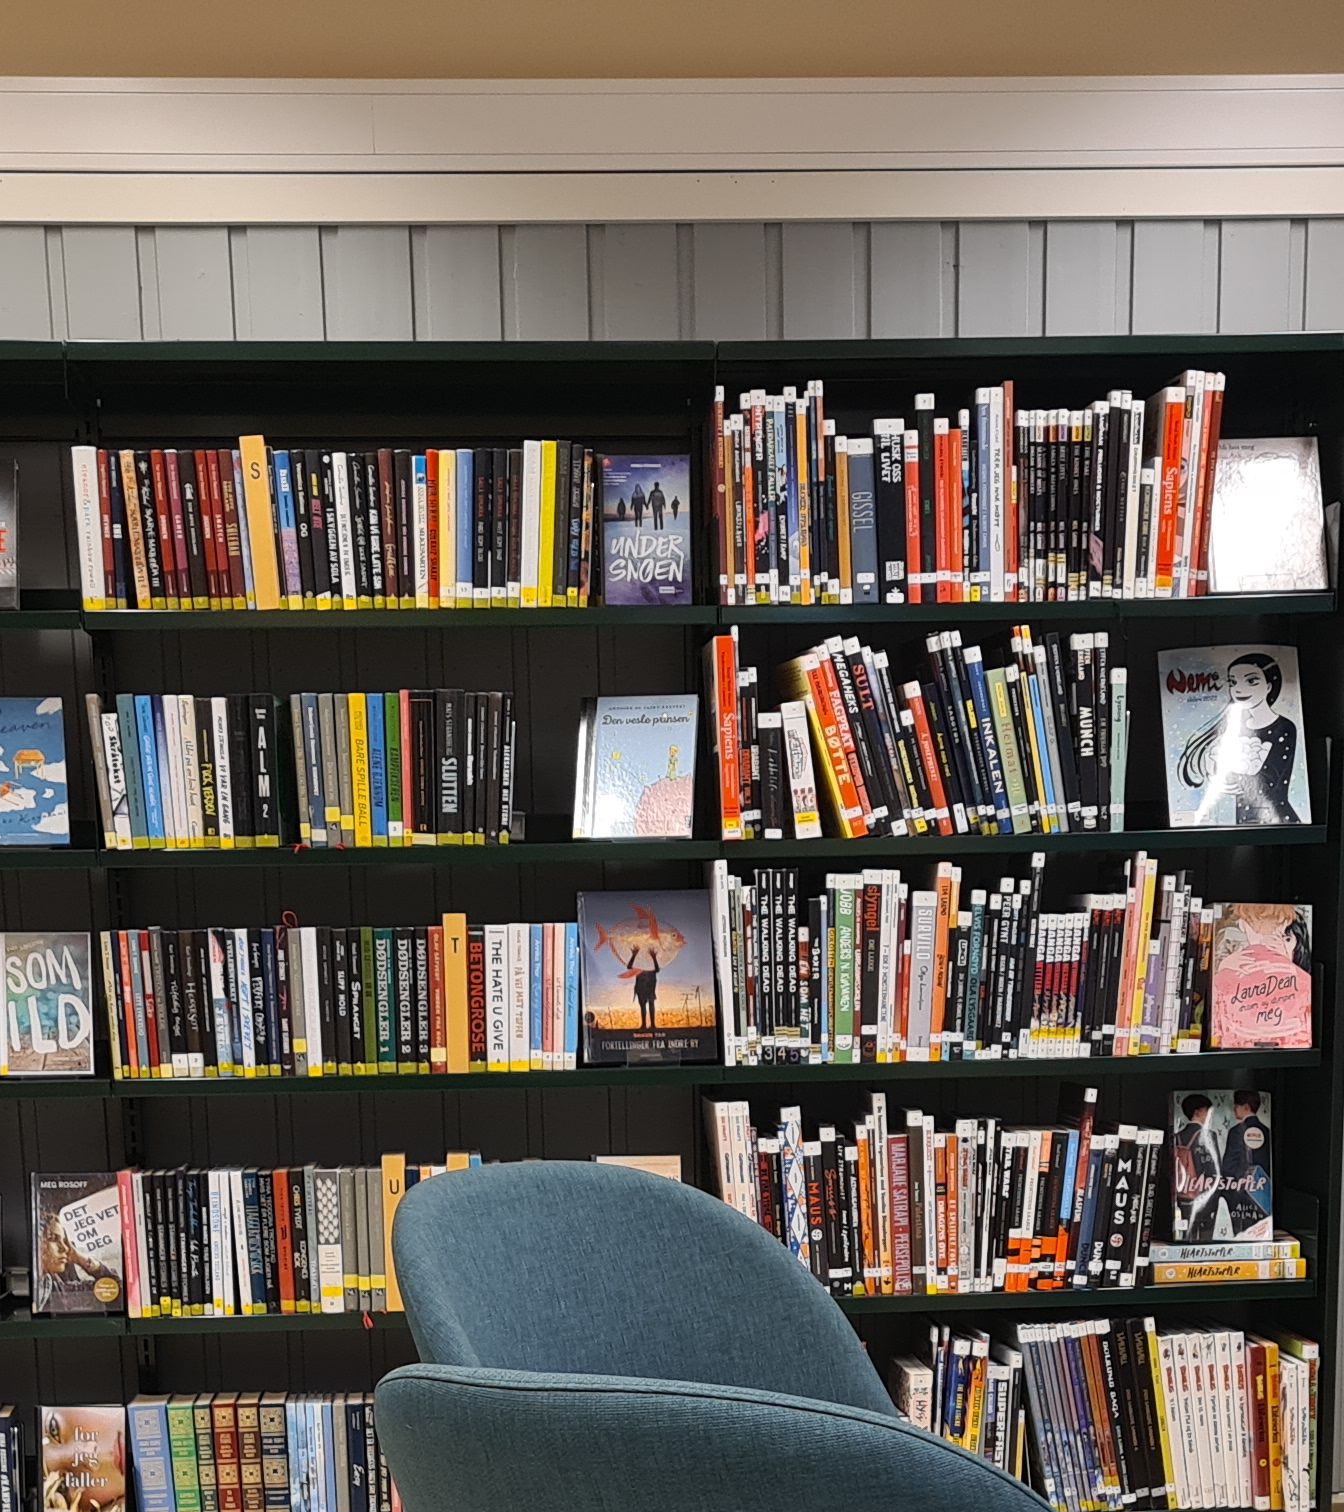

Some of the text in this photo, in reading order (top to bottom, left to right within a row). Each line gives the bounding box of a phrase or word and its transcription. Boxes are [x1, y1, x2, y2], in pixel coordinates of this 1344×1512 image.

[251, 462, 261, 479] S
[881, 452, 891, 483] LIVET
[892, 464, 901, 483] OSS
[1164, 467, 1177, 515] Sapiens
[852, 491, 873, 532] GISSEL
[610, 529, 684, 559] UNDER
[832, 654, 858, 714] MEGAHEKS
[852, 664, 874, 710] SULT
[1166, 668, 1222, 696] Nemi
[601, 714, 624, 726] Den
[652, 714, 690, 728] prinsen
[721, 713, 734, 760] Sapiens
[830, 689, 855, 750] FAGPRAT
[1078, 706, 1094, 757] MUNCH
[109, 736, 121, 784] Skråtekst
[824, 725, 850, 785] BØTTE
[981, 717, 1003, 794] INKALEN
[355, 738, 368, 827] BARE SPILLE BALL
[441, 757, 458, 813] SLUTTEN
[775, 895, 783, 915] THE
[788, 895, 796, 914] THE
[839, 888, 852, 915] JOBB
[864, 885, 880, 931] slyngel
[973, 907, 982, 929] ELVIS
[1000, 895, 1011, 943] PEER GYNT
[451, 937, 459, 953] T
[761, 918, 769, 962] WALKING
[775, 918, 784, 962] WALKING
[788, 918, 796, 962] WALKING
[839, 926, 851, 959] ANDERS
[915, 908, 933, 960] SURVILO
[971, 932, 981, 974] FORNØYD
[6, 945, 82, 994] SOM
[337, 970, 345, 991] SLIPP
[762, 965, 770, 993] DEAD
[776, 965, 784, 993] DEAD
[969, 978, 978, 995] OLA
[1231, 981, 1266, 1004] Laura
[1265, 974, 1299, 998] Dean
[375, 939, 388, 1041] DØDSENGLER
[397, 939, 411, 1054] DØDSENGLER 2
[416, 938, 428, 1053] DØDSENGLER 3
[470, 942, 484, 1052] BETONGROSE
[491, 939, 504, 1051] THE HATE U GIVE
[8, 993, 91, 1054] ILD
[351, 981, 361, 1039] SPRANGET
[1256, 1007, 1283, 1027] meg
[891, 1143, 904, 1187] MARJANE
[389, 1179, 400, 1195] U
[808, 1182, 822, 1225] MAUS
[1113, 1158, 1132, 1225] MAUS
[63, 1203, 88, 1222] DET
[73, 1205, 119, 1232] JEG VET
[893, 1188, 907, 1226] SATRAPI
[938, 1201, 946, 1238] DRAGENS
[77, 1227, 99, 1242] OM
[86, 1234, 113, 1252] DEG
[1179, 1247, 1235, 1258] HEARTSTOPPER
[1187, 1265, 1242, 1278] HEARTSTOPPER
[71, 1448, 100, 1468] jeg
[352, 1464, 365, 1487] Easy
[64, 1470, 110, 1489] faller
